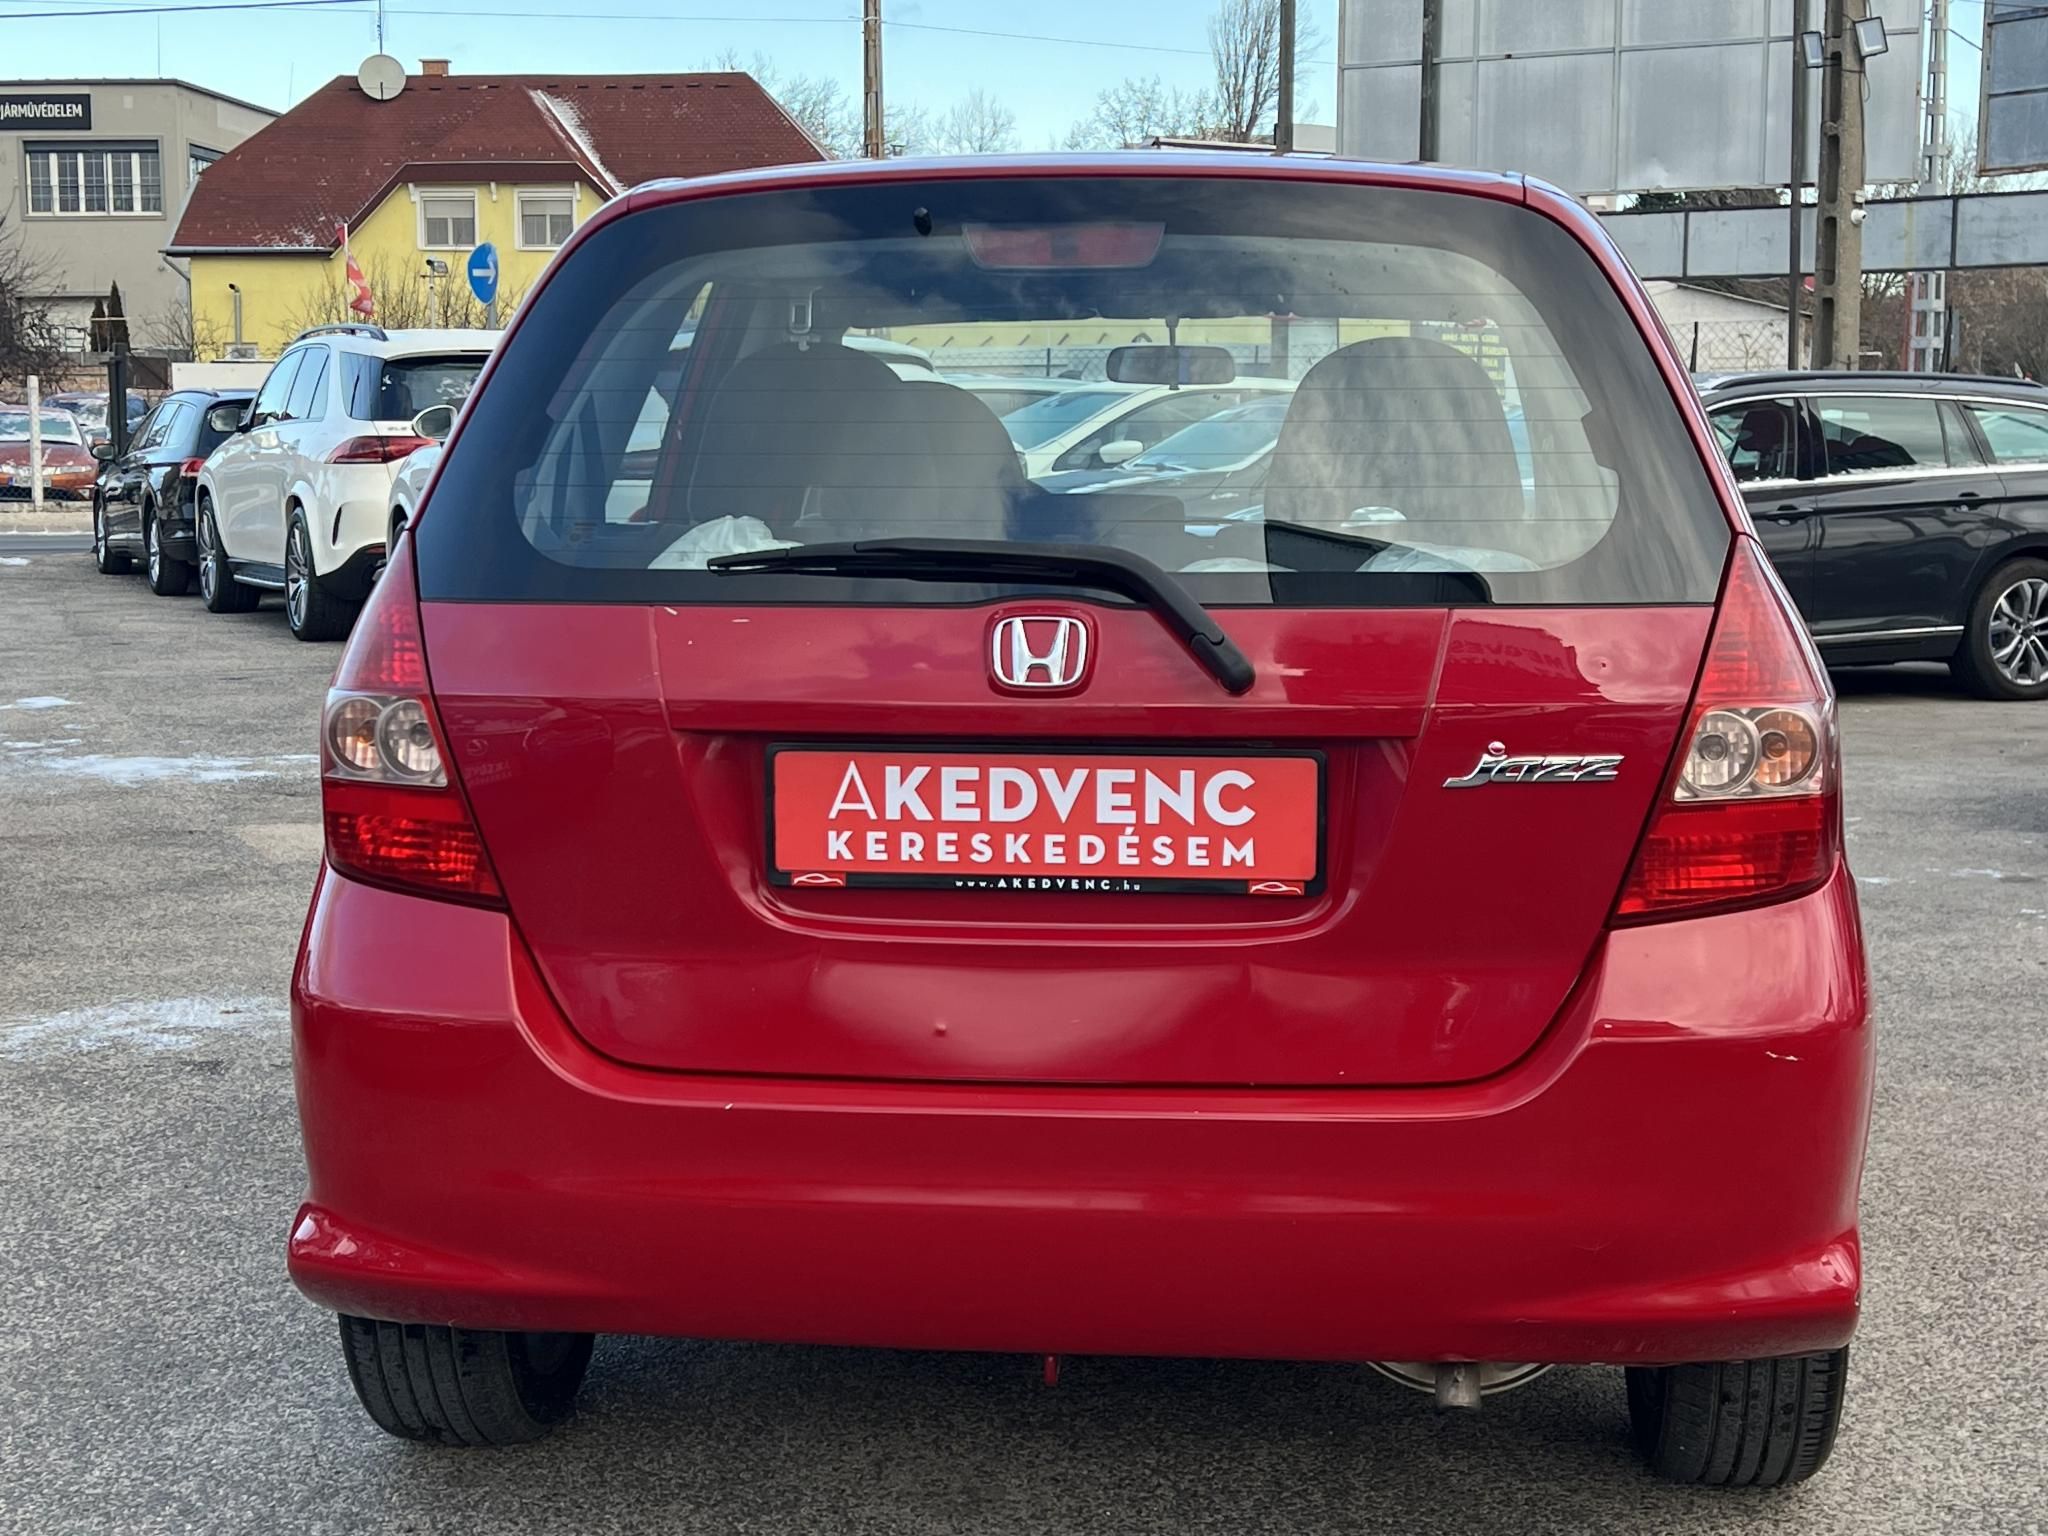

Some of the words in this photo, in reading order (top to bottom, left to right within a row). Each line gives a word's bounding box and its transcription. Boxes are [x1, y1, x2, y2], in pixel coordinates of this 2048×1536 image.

[828, 760, 1257, 826] AKEDVENC
[827, 827, 1256, 868] KERESKEDÉSEM
[955, 877, 1141, 892] www.AKEDVENC.hu
